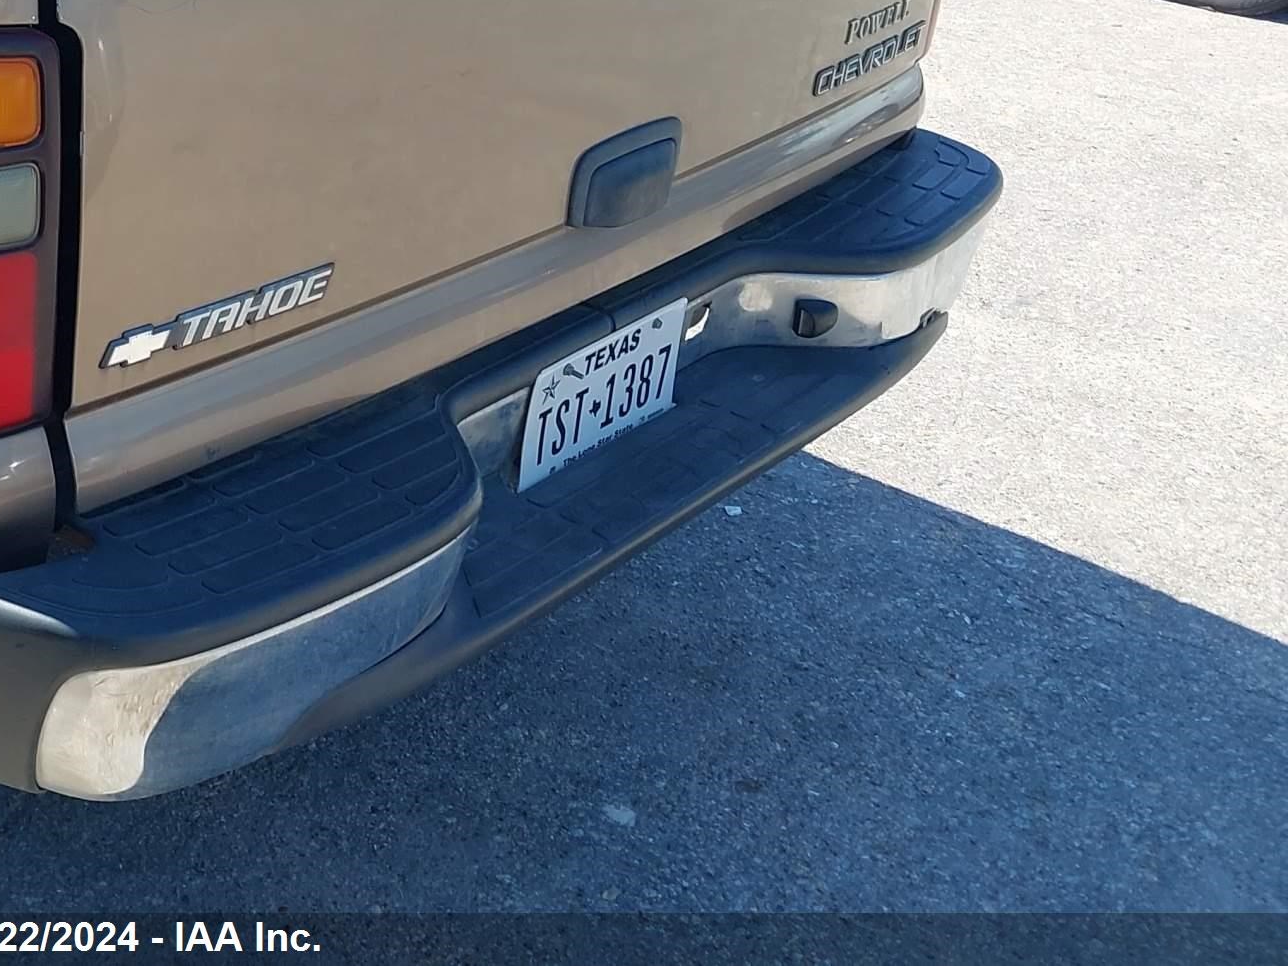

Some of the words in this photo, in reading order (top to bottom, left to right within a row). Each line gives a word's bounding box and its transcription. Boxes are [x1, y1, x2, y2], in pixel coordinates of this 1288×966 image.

[813, 20, 926, 96] CHEVROLET
[182, 268, 333, 347] TAHOE
[584, 328, 641, 375] TEXAS
